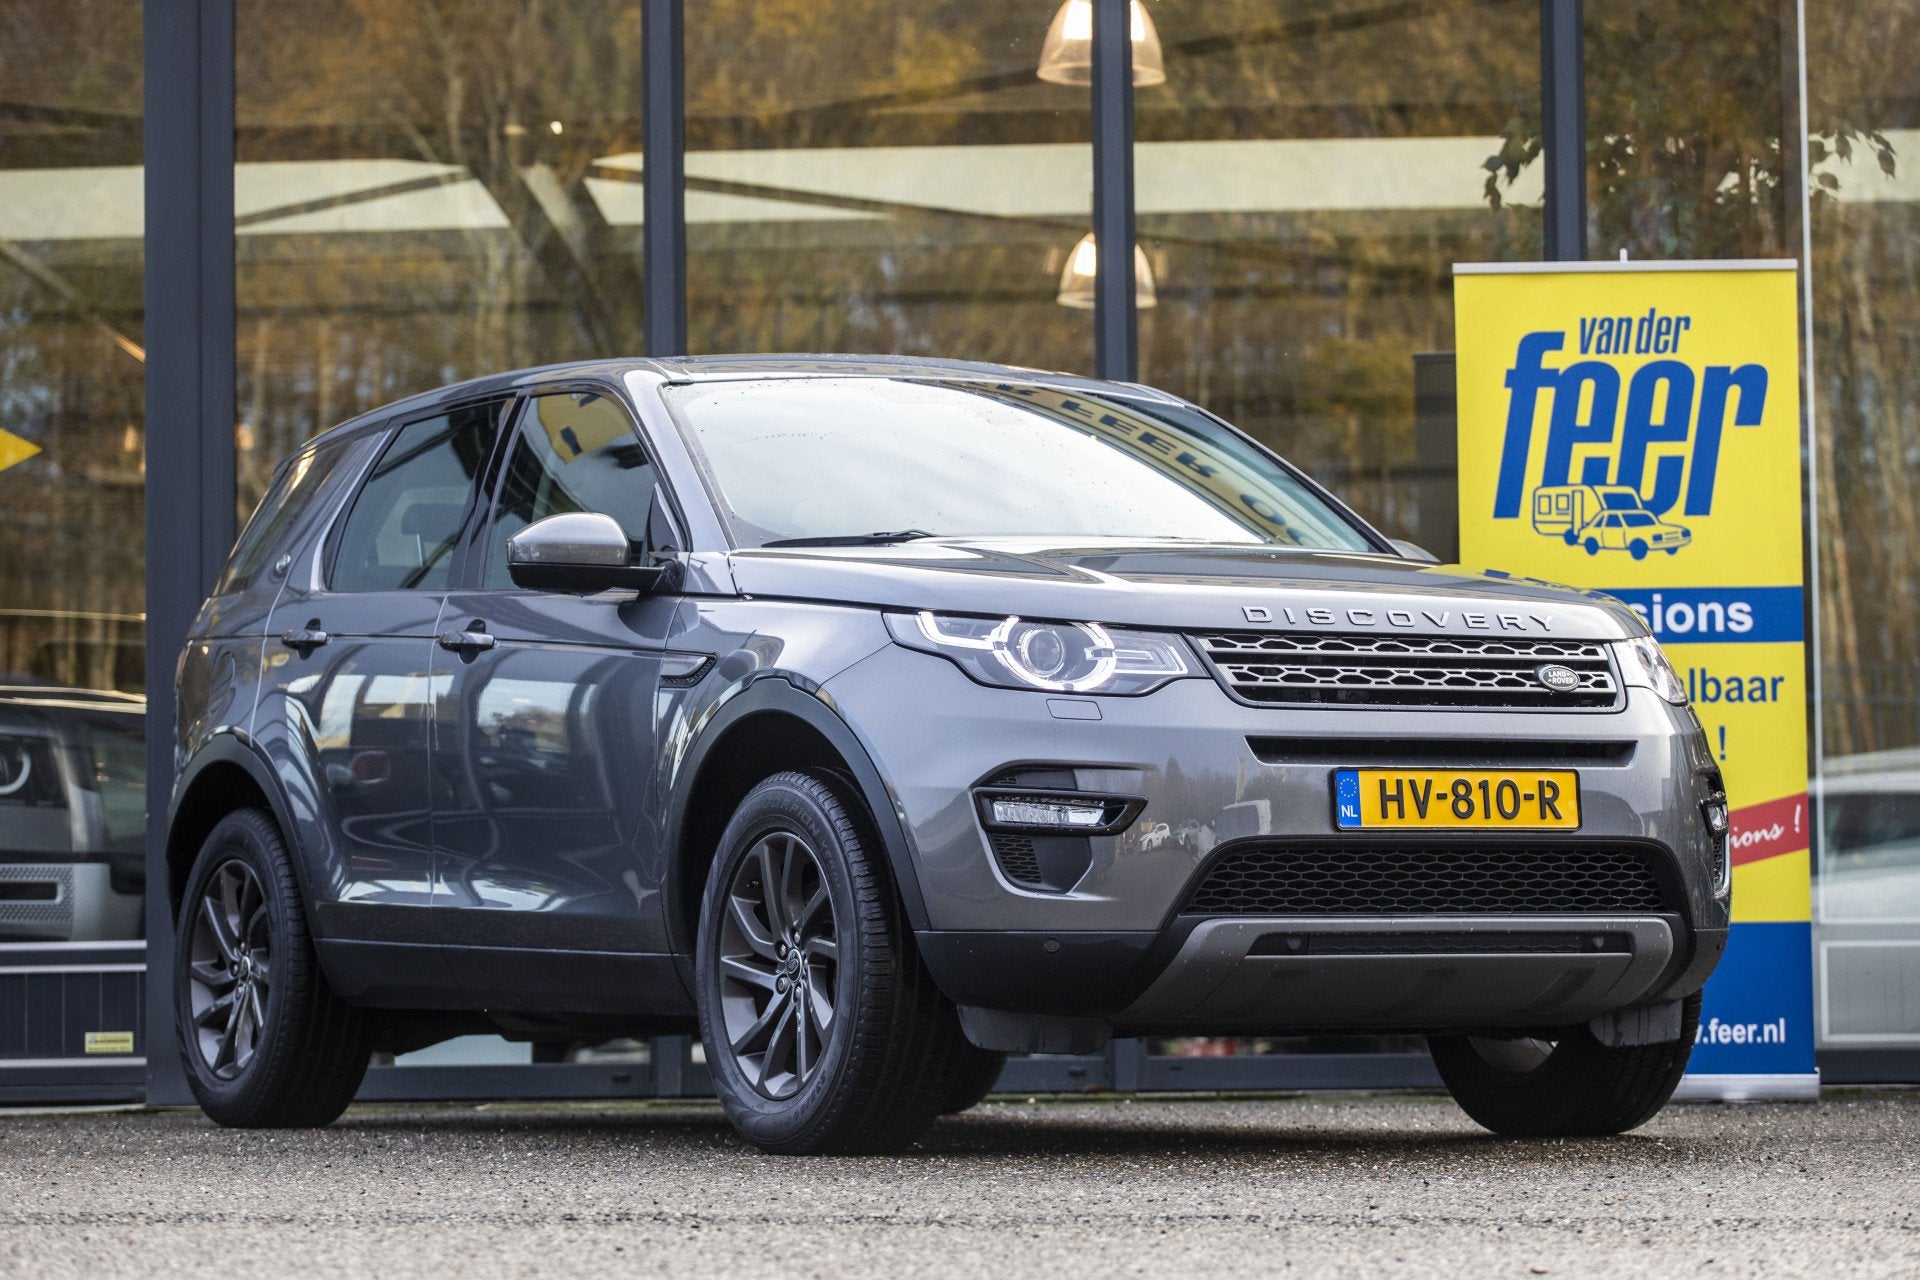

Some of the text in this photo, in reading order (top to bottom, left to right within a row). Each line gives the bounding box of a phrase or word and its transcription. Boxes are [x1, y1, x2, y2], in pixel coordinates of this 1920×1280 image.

[1580, 307, 1691, 355] van der
[1493, 331, 1769, 519] feer
[1241, 605, 1555, 632] DISCOVERY
[1548, 670, 1567, 678] LAND
[1552, 677, 1574, 685] ROVER
[1680, 667, 1785, 703] lbaar
[1340, 804, 1358, 818] NL
[1379, 778, 1563, 820] HV-810-R
